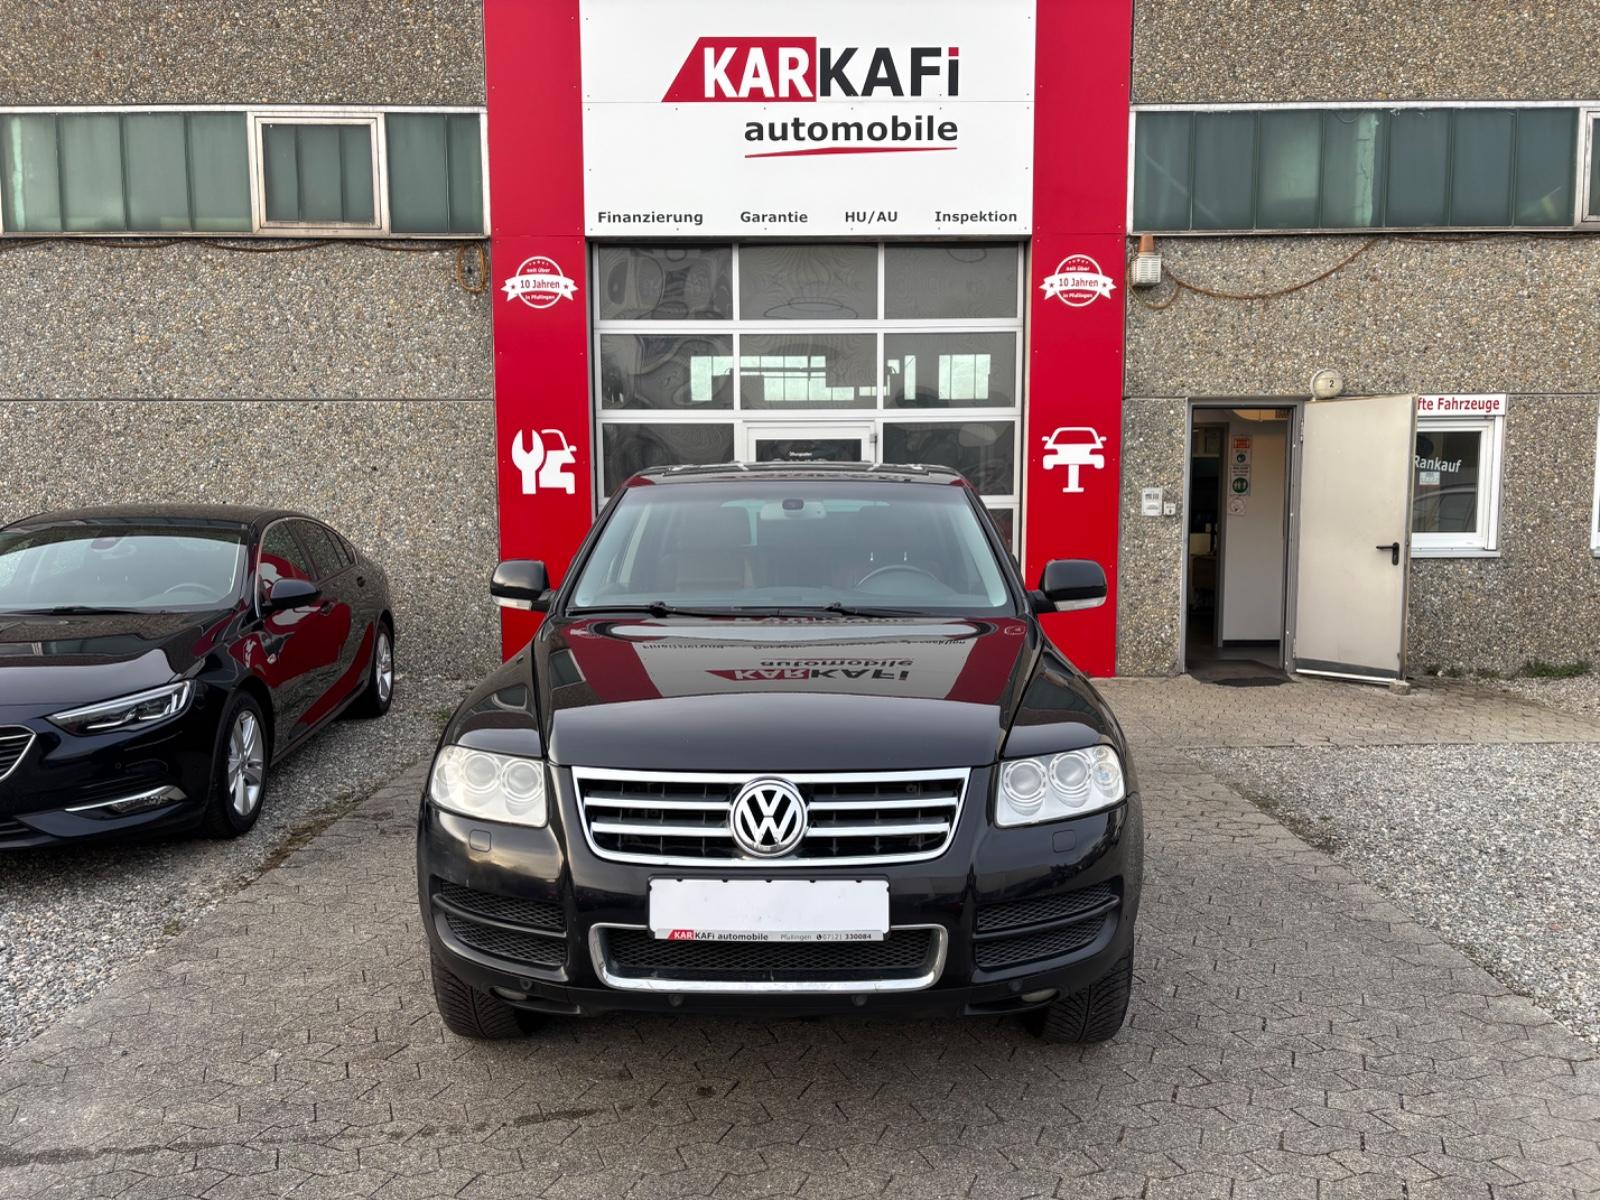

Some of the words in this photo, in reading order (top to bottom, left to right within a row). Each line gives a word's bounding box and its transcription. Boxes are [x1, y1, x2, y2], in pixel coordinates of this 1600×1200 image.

[704, 47, 959, 98] KARKAFi
[744, 115, 958, 142] automobile
[598, 211, 703, 225] Finanzierung
[740, 211, 809, 223] Garantie
[845, 211, 898, 224] HU/AU
[935, 210, 1017, 224] Inspektion
[520, 279, 530, 289] 10
[532, 279, 560, 289] Jahren
[1058, 278, 1069, 287] 10
[1071, 277, 1099, 287] Jahren
[1329, 379, 1334, 388] 2
[1437, 397, 1500, 413] Fahrzeuge
[674, 931, 715, 940] KARKAFi
[717, 932, 769, 941] automobile
